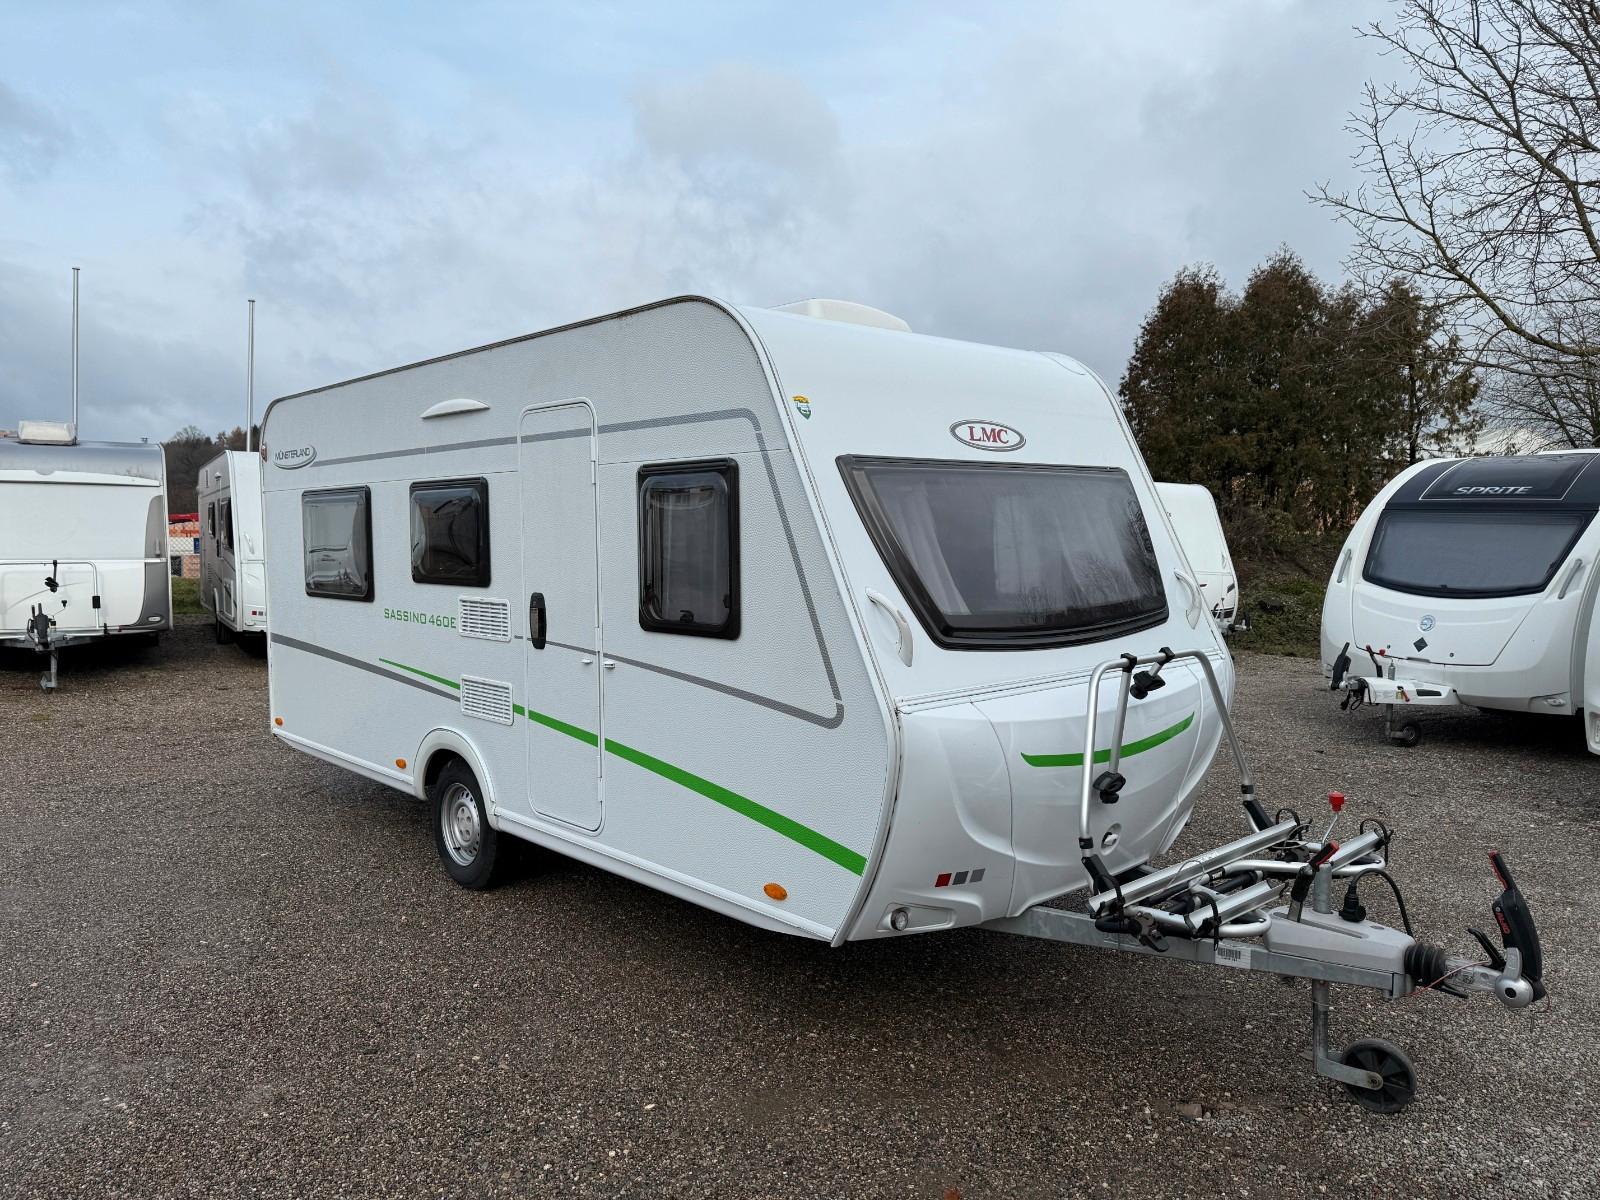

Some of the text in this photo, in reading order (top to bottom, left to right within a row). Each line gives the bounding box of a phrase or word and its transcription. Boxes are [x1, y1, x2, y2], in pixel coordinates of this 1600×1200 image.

[967, 425, 1009, 445] LMC
[383, 608, 457, 629] SASSINO 460E
